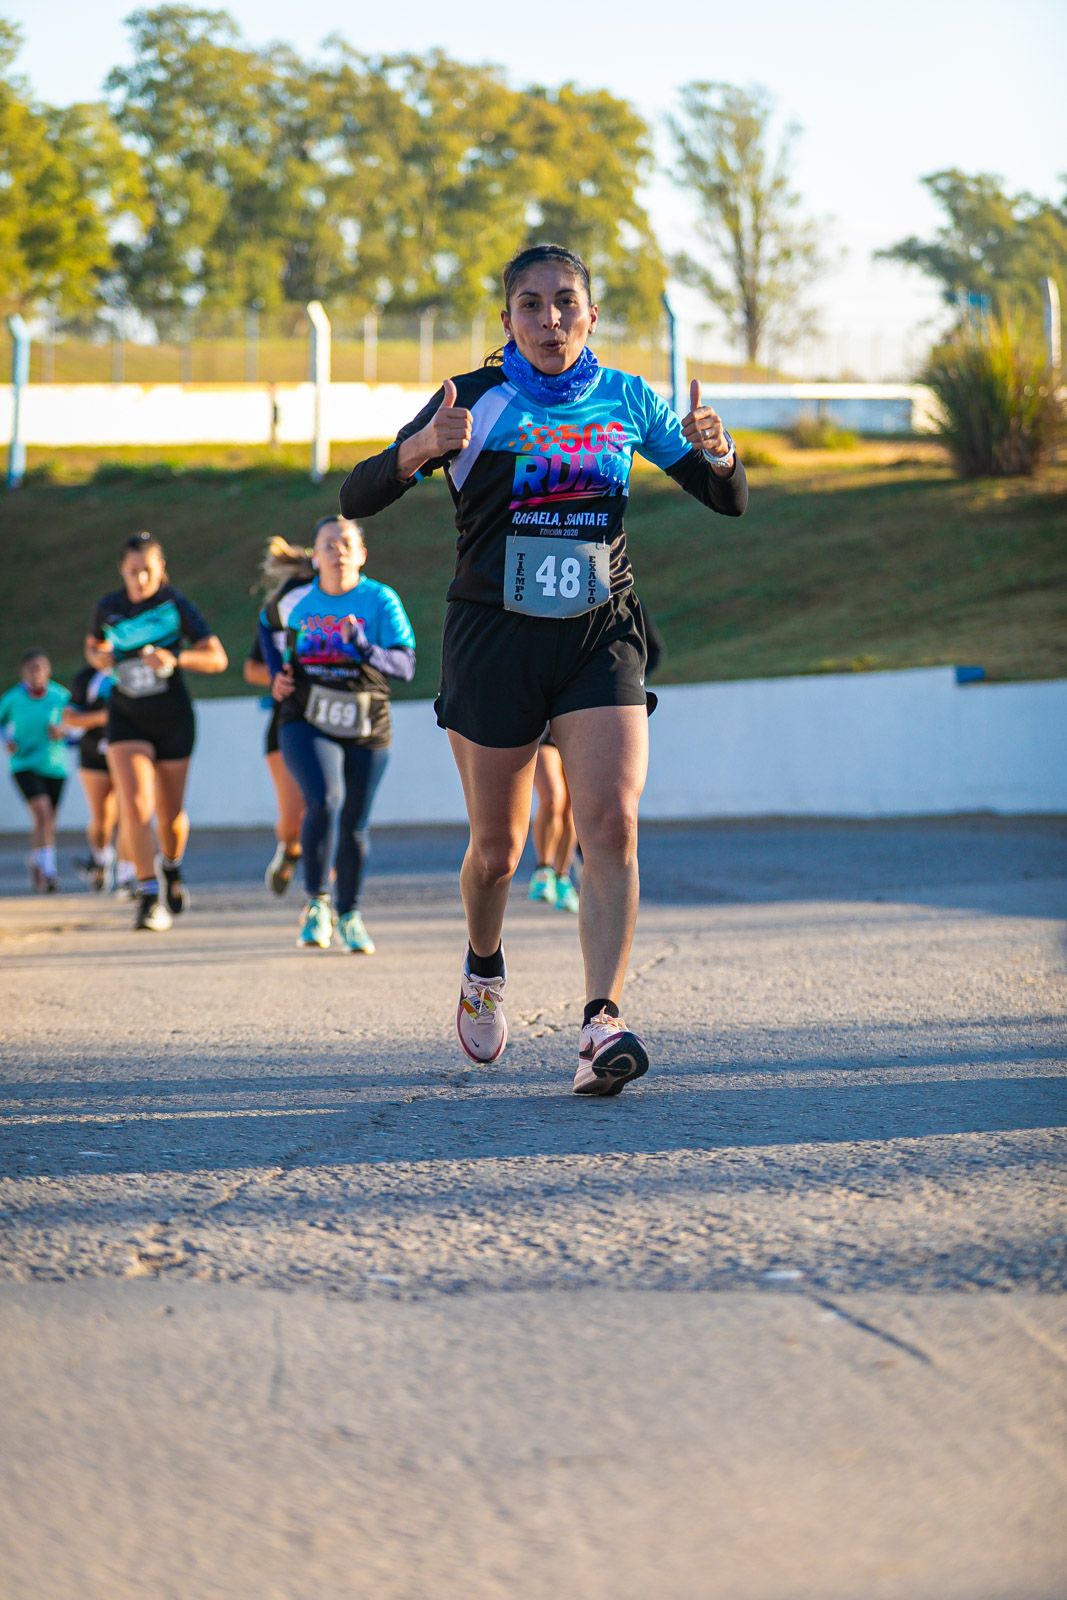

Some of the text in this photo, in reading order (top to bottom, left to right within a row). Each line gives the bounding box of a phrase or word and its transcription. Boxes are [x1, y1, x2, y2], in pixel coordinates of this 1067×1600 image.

[512, 454, 618, 496] RUN
[512, 511, 609, 527] RAFAELA, SANTA FE
[563, 528, 579, 537] 2026
[514, 552, 526, 602] TIEMPO
[535, 555, 581, 599] 48
[587, 555, 597, 605] EXACTO
[315, 698, 358, 728] 169
